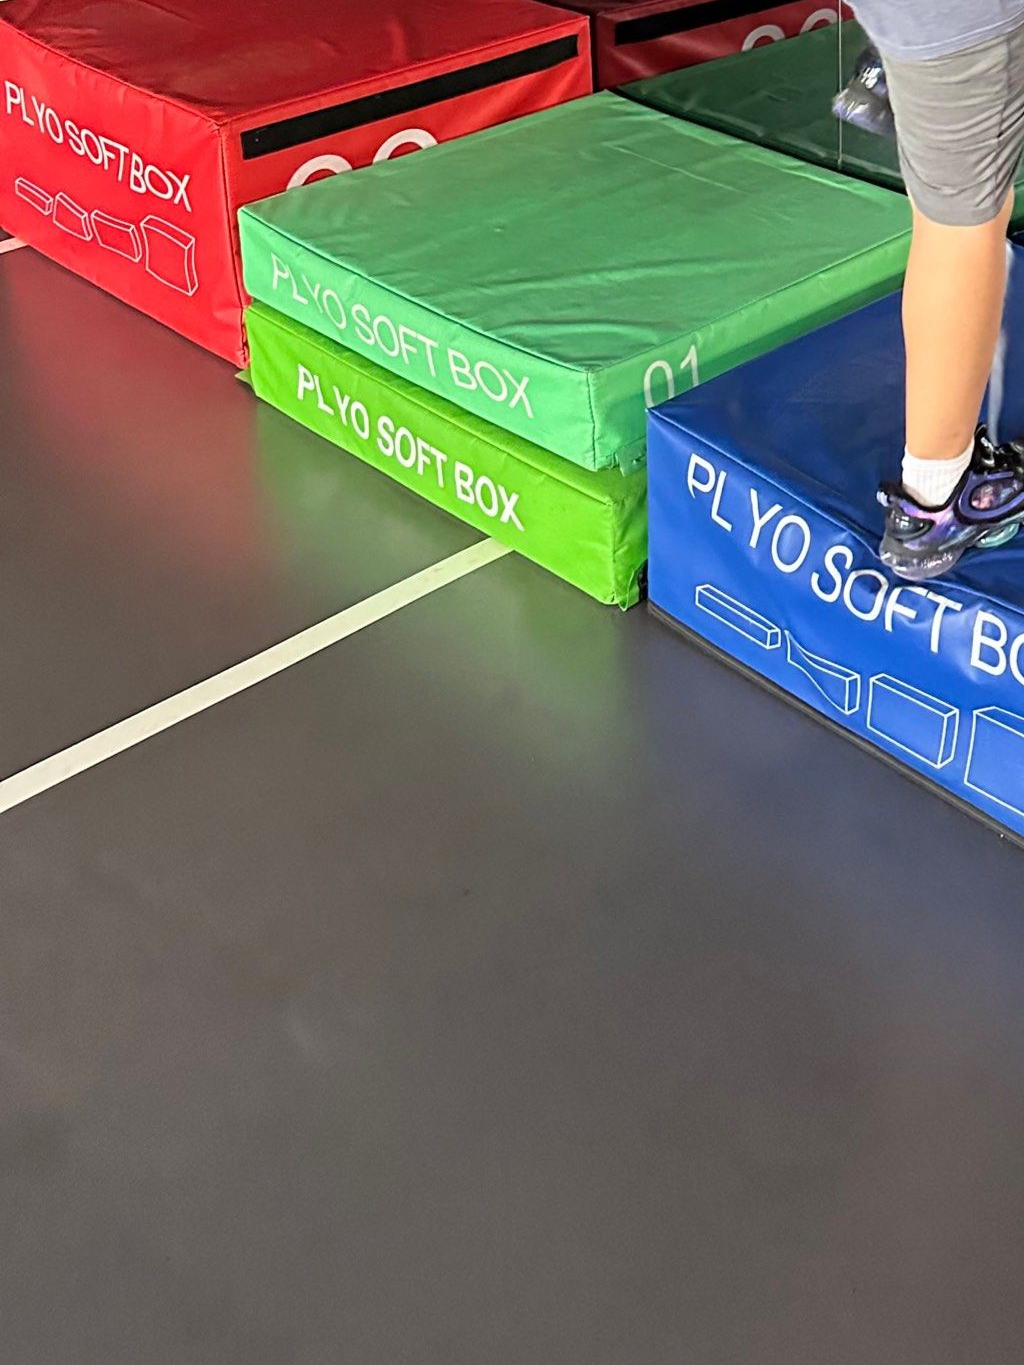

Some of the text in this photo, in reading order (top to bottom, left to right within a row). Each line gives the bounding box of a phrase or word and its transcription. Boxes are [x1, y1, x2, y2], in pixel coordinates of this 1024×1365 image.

[5, 80, 192, 212] PLYO SOFT BOX
[271, 252, 534, 418] PLYO SOFT BOX
[644, 344, 700, 408] 01
[297, 363, 525, 531] PLYO SOFT BOX
[687, 452, 811, 574] PLYO
[810, 544, 963, 653] SOFT
